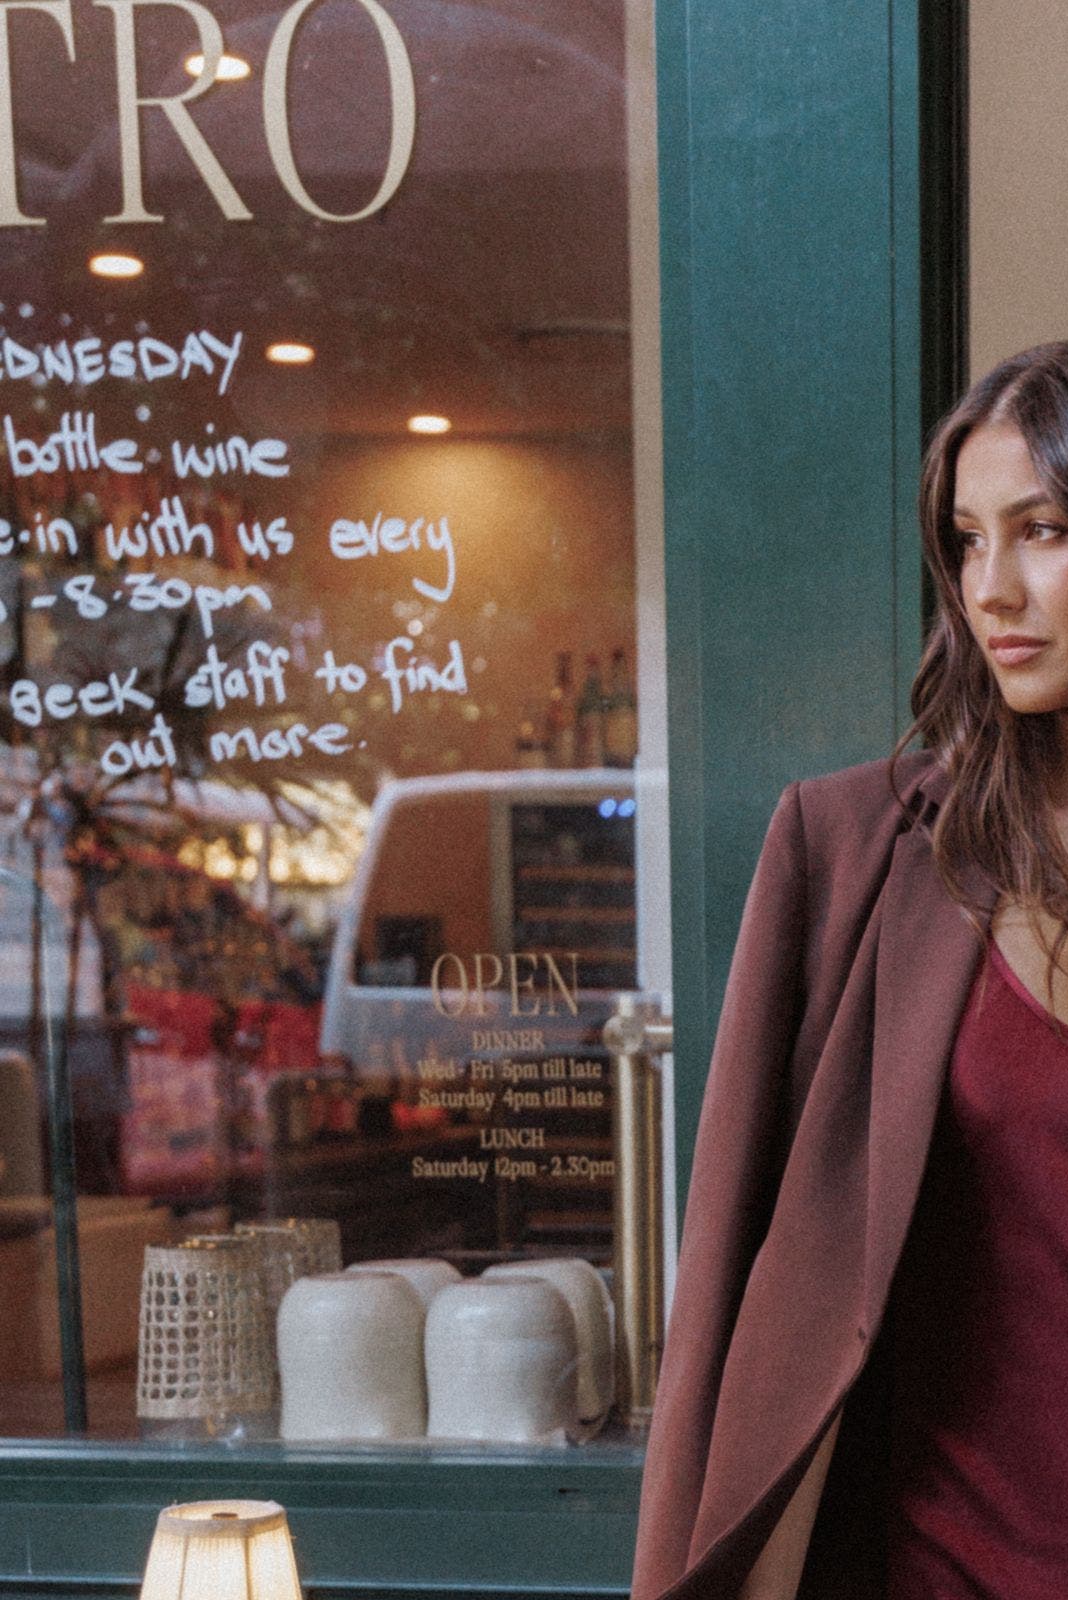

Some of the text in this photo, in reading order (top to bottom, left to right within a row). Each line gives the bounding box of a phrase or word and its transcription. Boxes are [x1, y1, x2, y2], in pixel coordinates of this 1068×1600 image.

[0, 330, 243, 396] DNESDAY
[4, 410, 290, 478] bottle wine
[105, 495, 214, 560] with
[237, 516, 294, 561] us
[329, 511, 456, 602] every
[184, 641, 290, 710] staff
[315, 650, 367, 693] to
[382, 636, 468, 714] find
[101, 712, 367, 775] out more.
[431, 952, 579, 1018] OPEN
[417, 1058, 455, 1079] Wed
[470, 1060, 494, 1079] Fri
[542, 1057, 566, 1079] till
[569, 1058, 602, 1079] late
[472, 1030, 545, 1050] DINNER
[418, 1087, 604, 1111] Saturday 4pm till late
[411, 1156, 489, 1182] Saturday
[550, 1155, 616, 1181] 2.30pm
[479, 1128, 545, 1148] LUNCH
